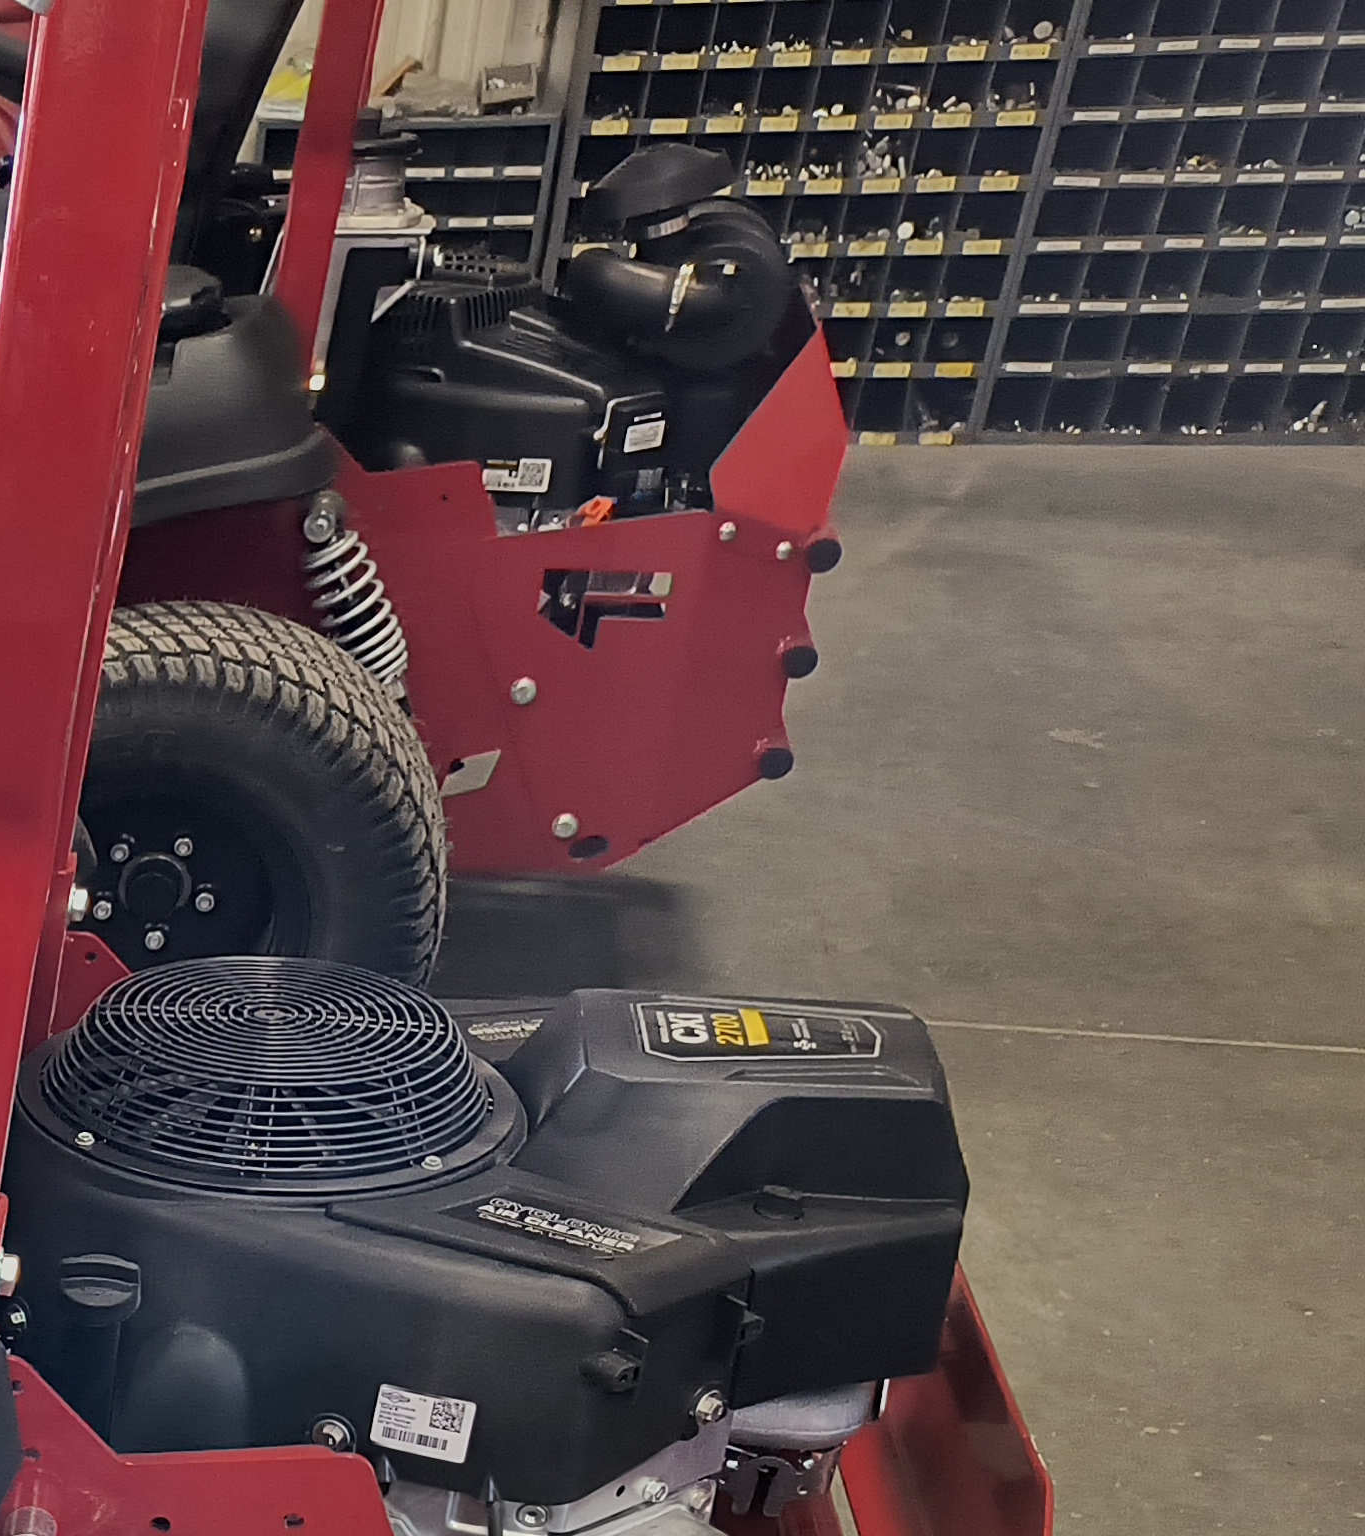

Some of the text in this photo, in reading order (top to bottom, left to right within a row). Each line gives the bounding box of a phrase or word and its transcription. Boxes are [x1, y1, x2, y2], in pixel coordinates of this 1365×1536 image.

[669, 1012, 710, 1045] CXi
[710, 1012, 745, 1047] 2700
[476, 1204, 519, 1219] AIR
[524, 1216, 634, 1251] CLEANER
[489, 1198, 640, 1243] CYCLONIC
